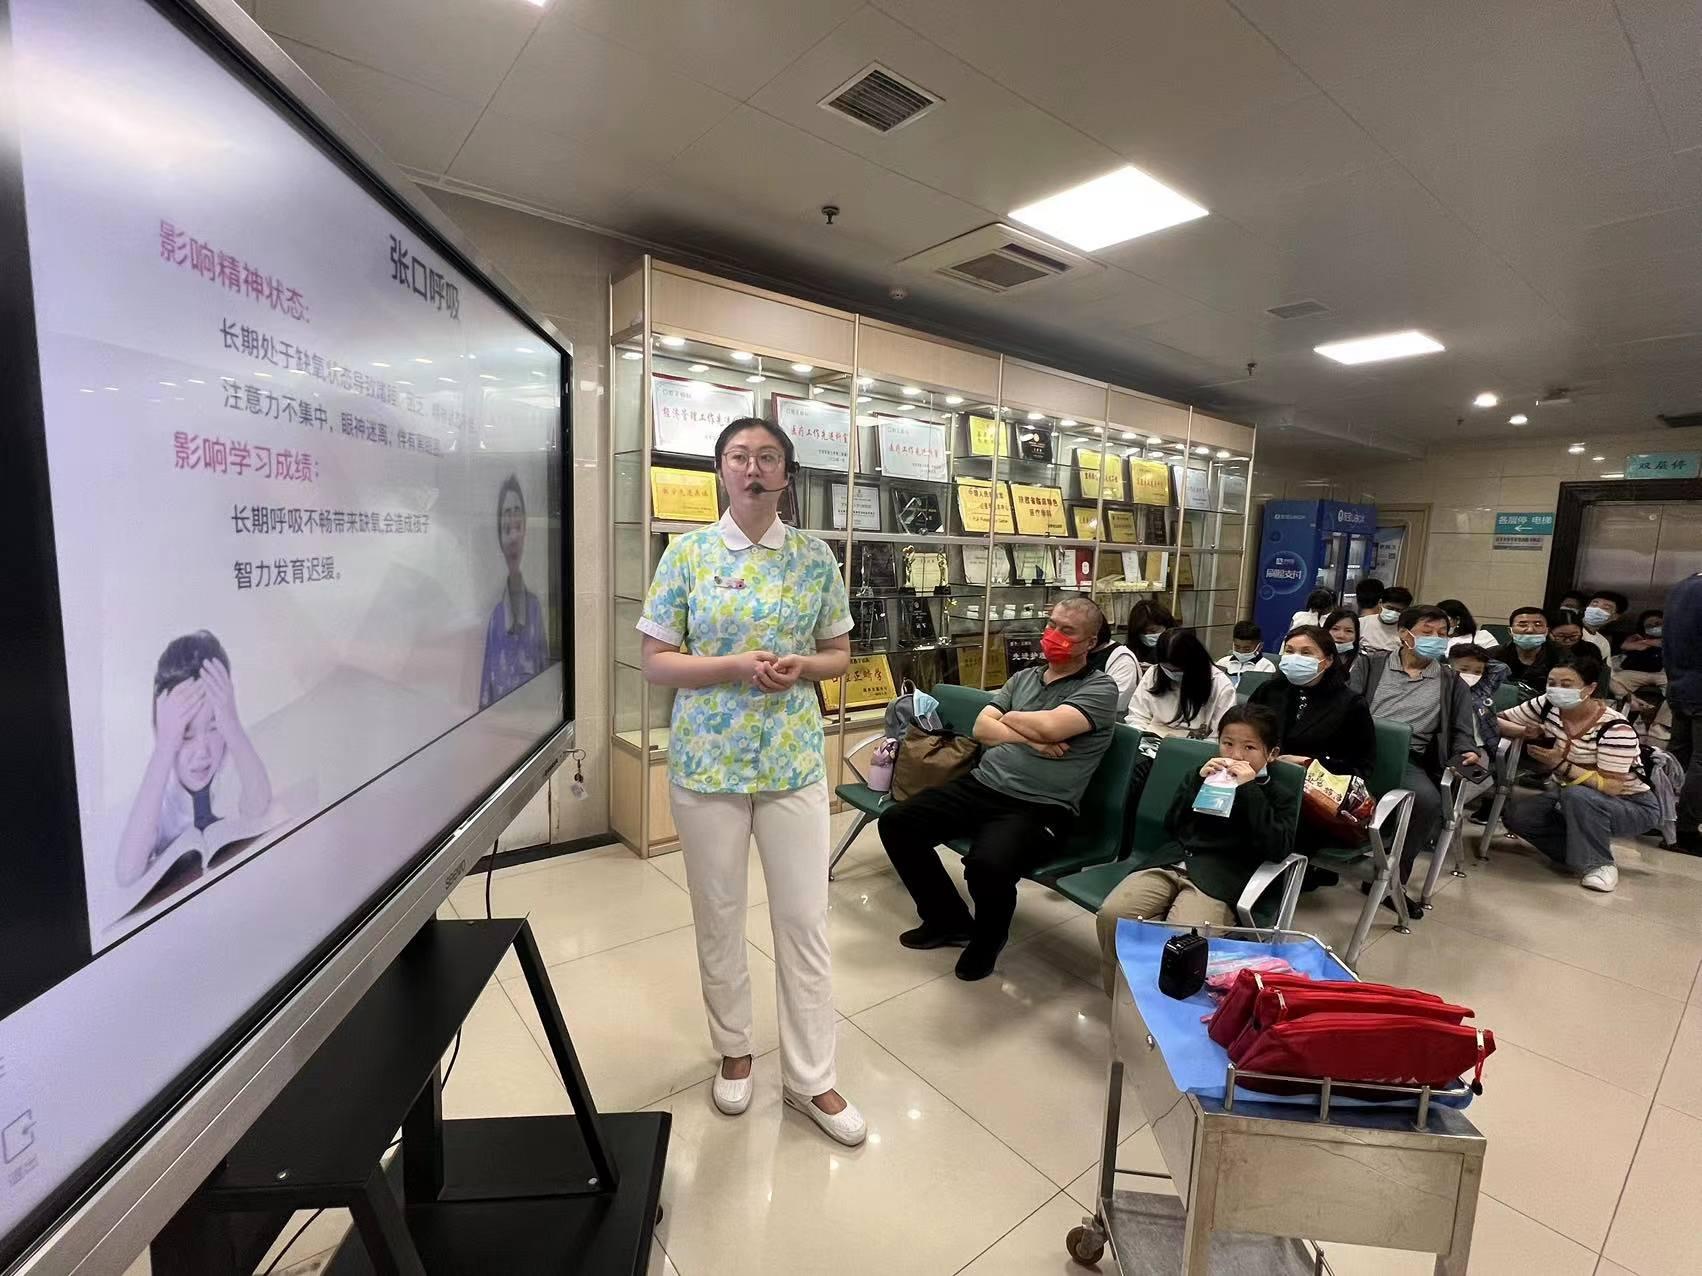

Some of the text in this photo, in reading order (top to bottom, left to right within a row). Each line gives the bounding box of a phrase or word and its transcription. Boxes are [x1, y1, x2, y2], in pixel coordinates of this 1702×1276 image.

[389, 233, 460, 321] 张口呼吸
[234, 556, 341, 590] 智力发育迟缓。
